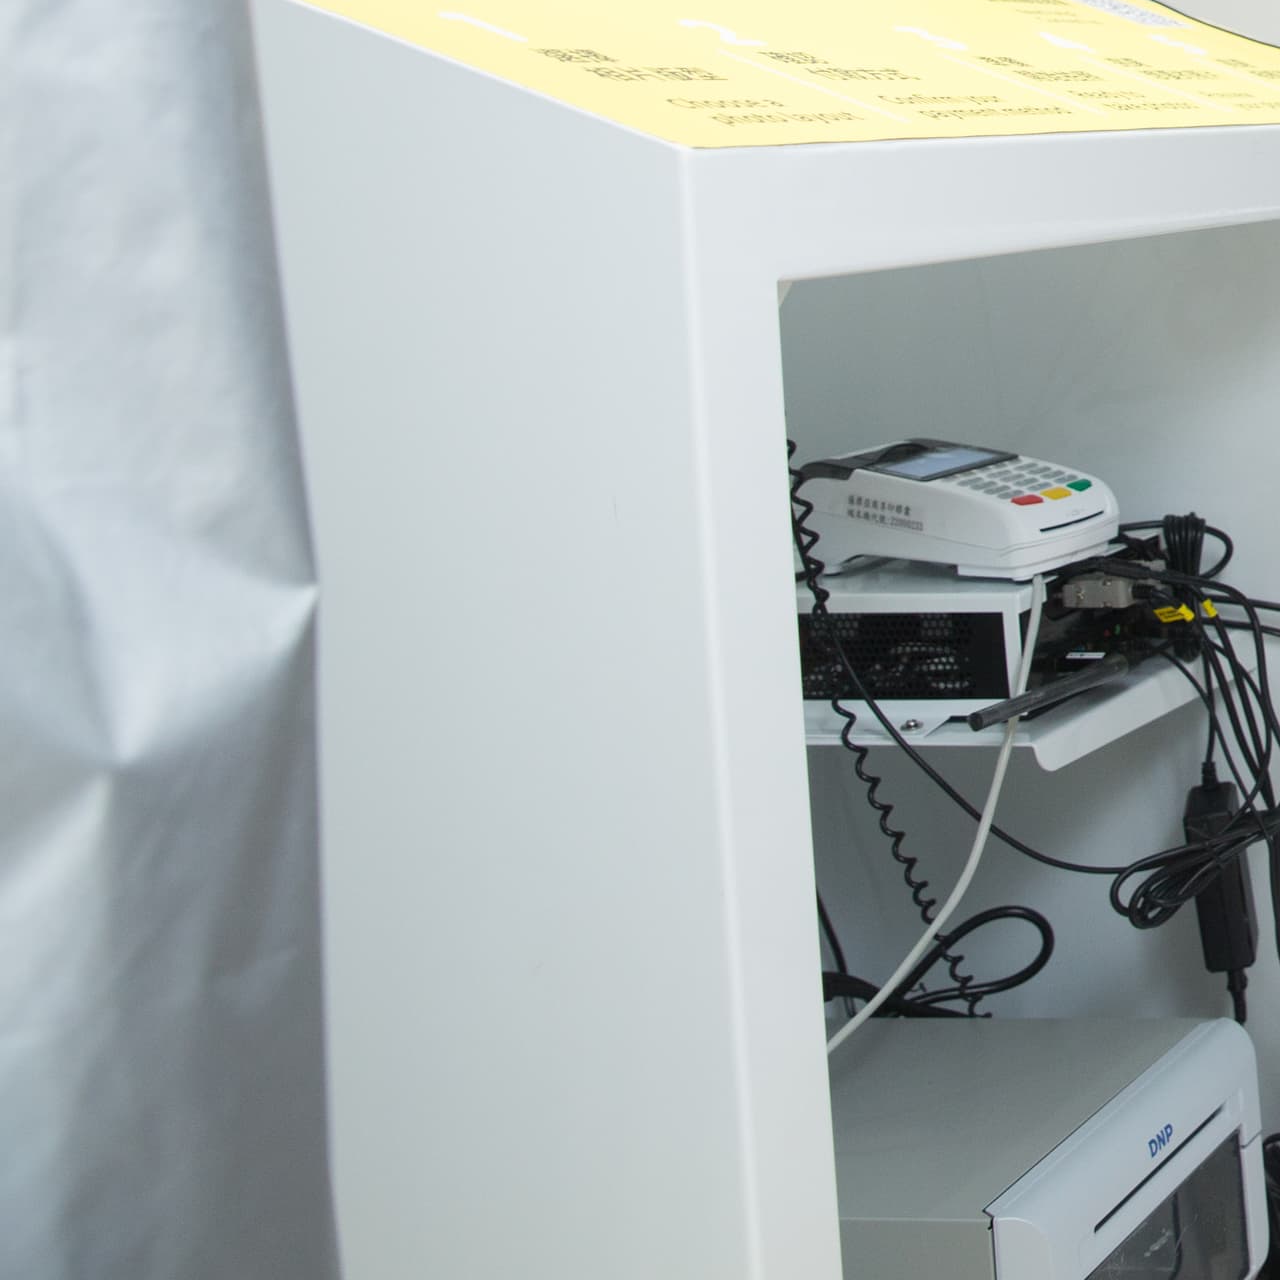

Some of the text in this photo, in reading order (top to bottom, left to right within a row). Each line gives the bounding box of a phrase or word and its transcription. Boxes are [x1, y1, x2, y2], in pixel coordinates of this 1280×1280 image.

[677, 19, 767, 46] 2
[581, 66, 727, 82] 相片版型
[664, 97, 768, 109] Choose
[877, 94, 960, 105] Confirm
[710, 110, 866, 127] photo layout
[1148, 1124, 1174, 1158] DNP
